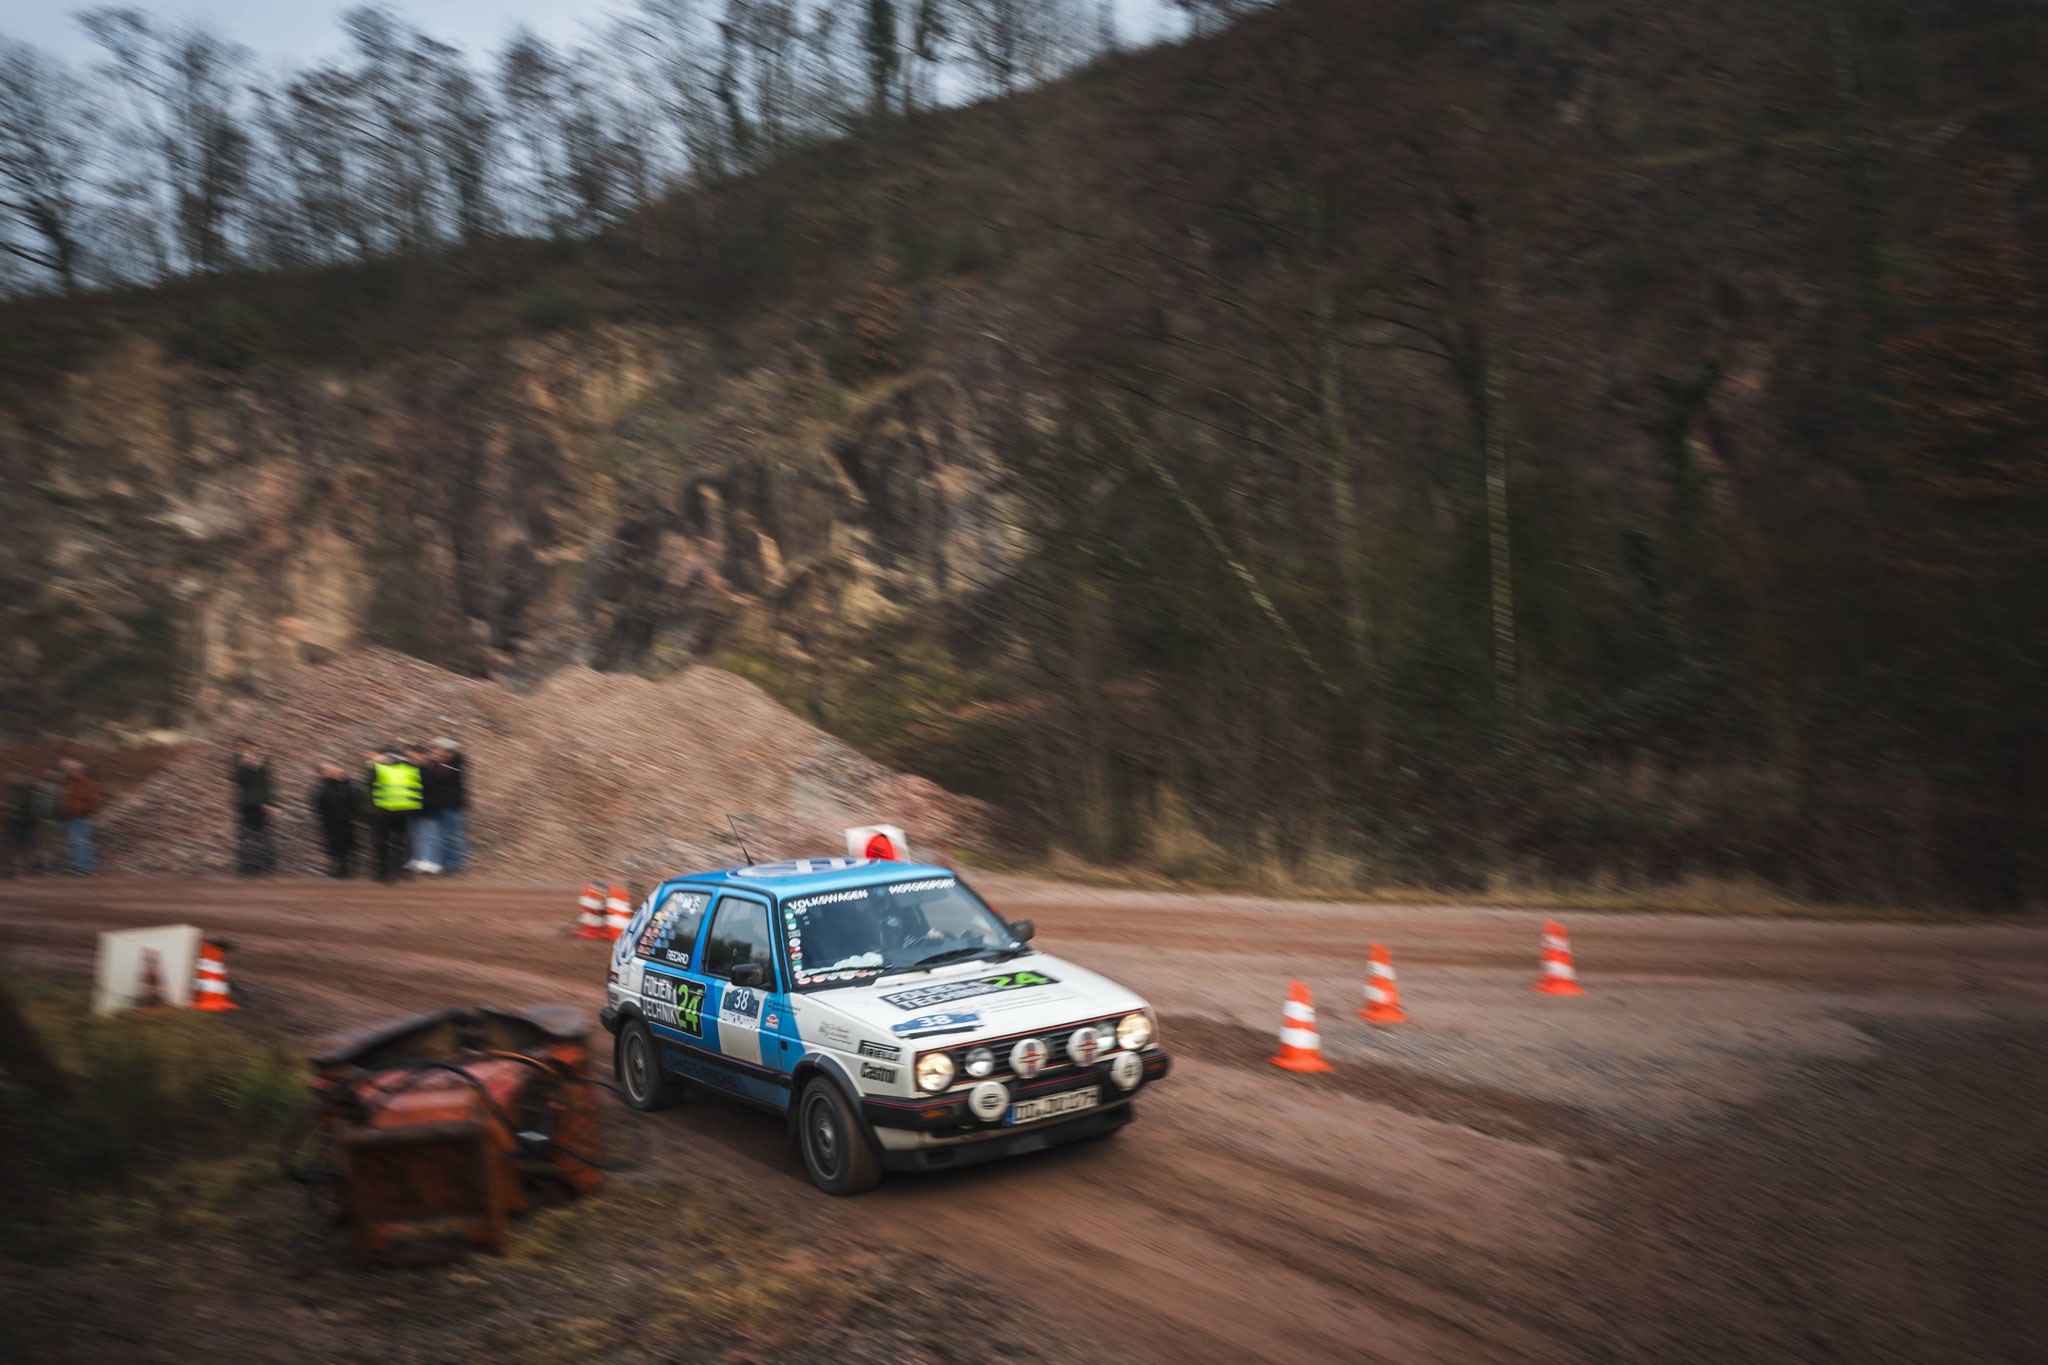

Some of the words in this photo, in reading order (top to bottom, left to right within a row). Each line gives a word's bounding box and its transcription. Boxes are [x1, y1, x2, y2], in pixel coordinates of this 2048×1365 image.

[666, 949, 690, 965] RECARO
[982, 971, 1048, 989] 24
[678, 983, 704, 1032] 24
[733, 988, 750, 1011] 38
[917, 1015, 953, 1028] 38
